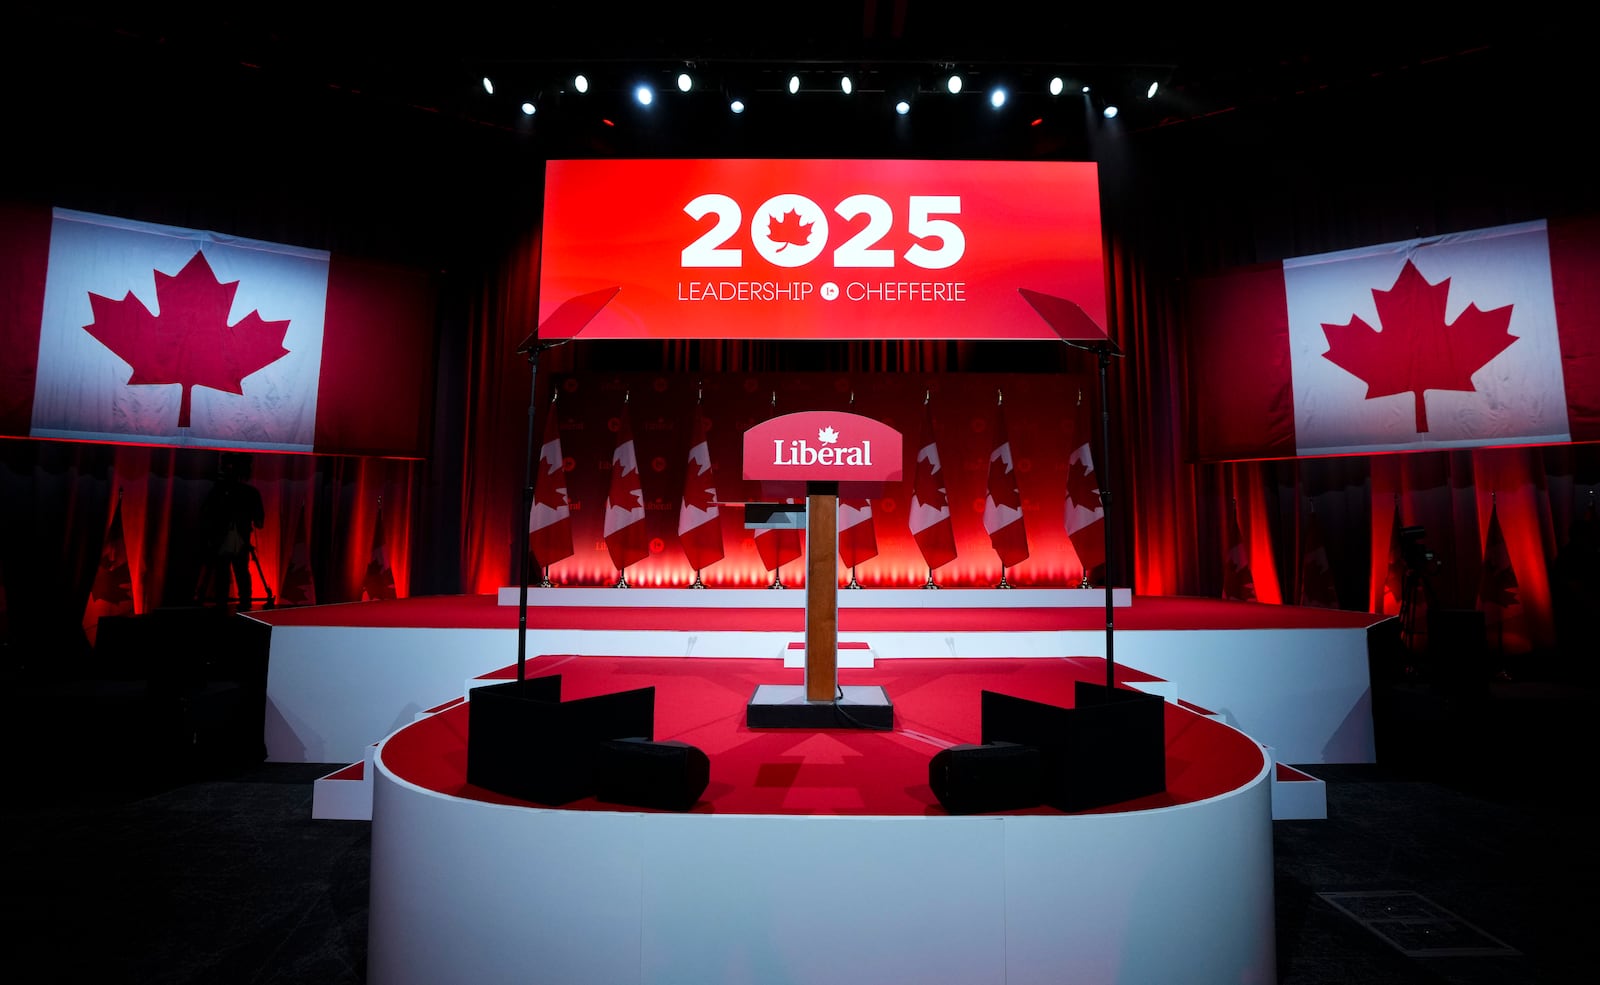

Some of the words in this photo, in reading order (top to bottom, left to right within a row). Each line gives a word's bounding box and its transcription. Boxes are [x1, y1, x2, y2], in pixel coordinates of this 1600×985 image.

[681, 193, 966, 270] 2025
[678, 281, 814, 302] LEADERSHIP
[846, 281, 967, 302] CHEFFERIE
[773, 436, 873, 467] Libéral
